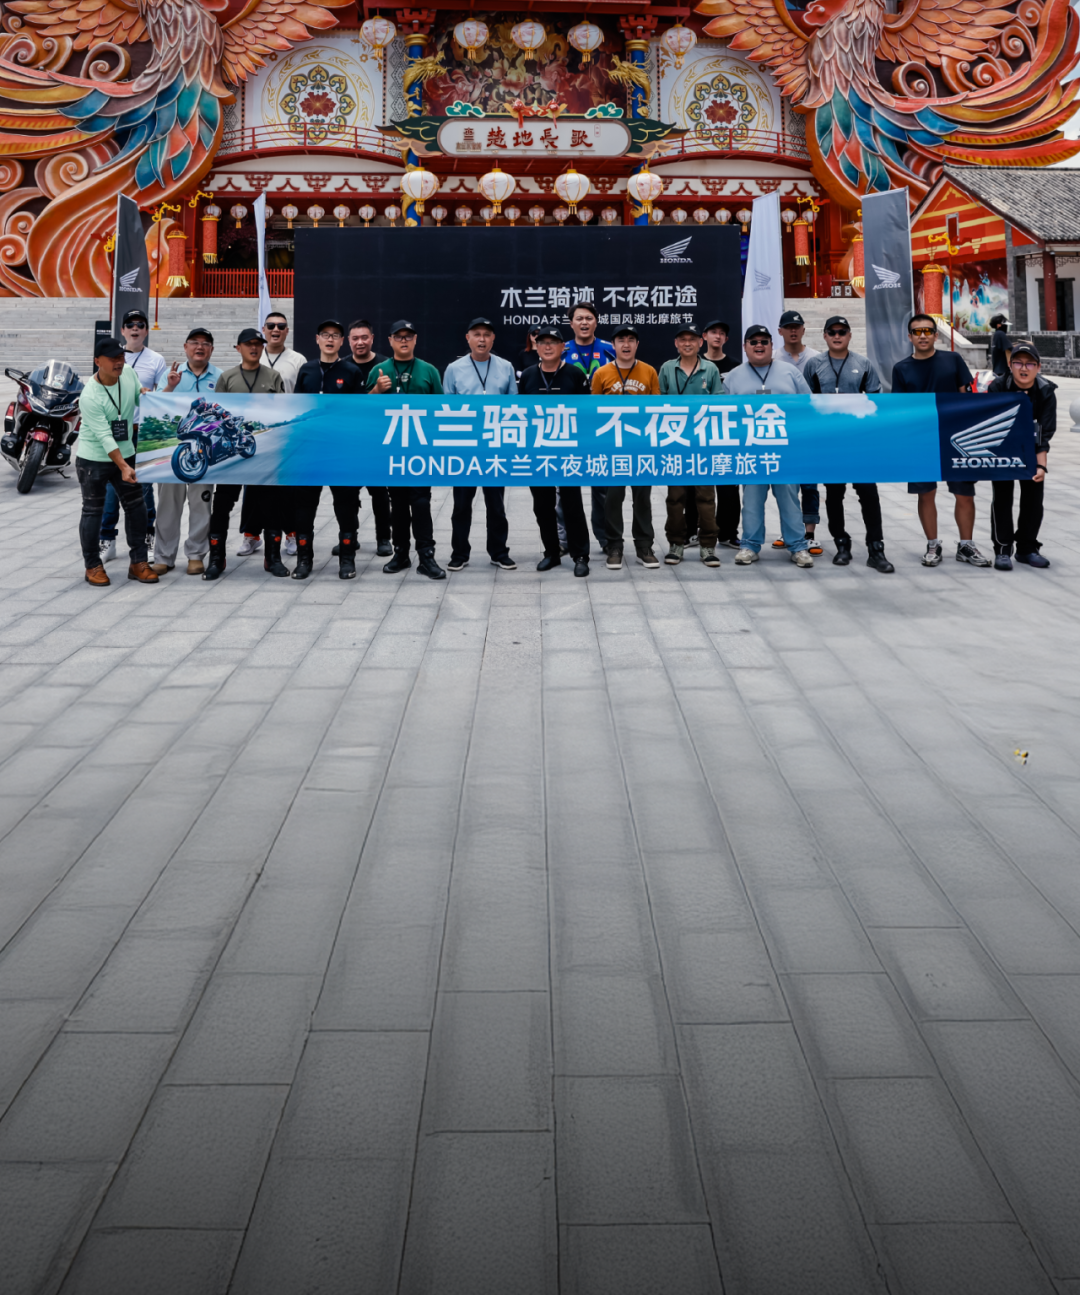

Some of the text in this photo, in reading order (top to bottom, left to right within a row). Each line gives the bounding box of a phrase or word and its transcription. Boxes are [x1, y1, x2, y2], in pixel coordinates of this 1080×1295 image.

[487, 126, 593, 149] 楚地長歌
[500, 285, 697, 308] 木兰骑迹 不夜征途
[503, 313, 694, 325] HONDA木兰城国风湖北摩旅节
[382, 403, 789, 448] 木兰骑迹 不夜征途
[389, 452, 781, 477] HONDA木兰不夜城国风湖北摩旅节
[951, 457, 1026, 468] HONDA
